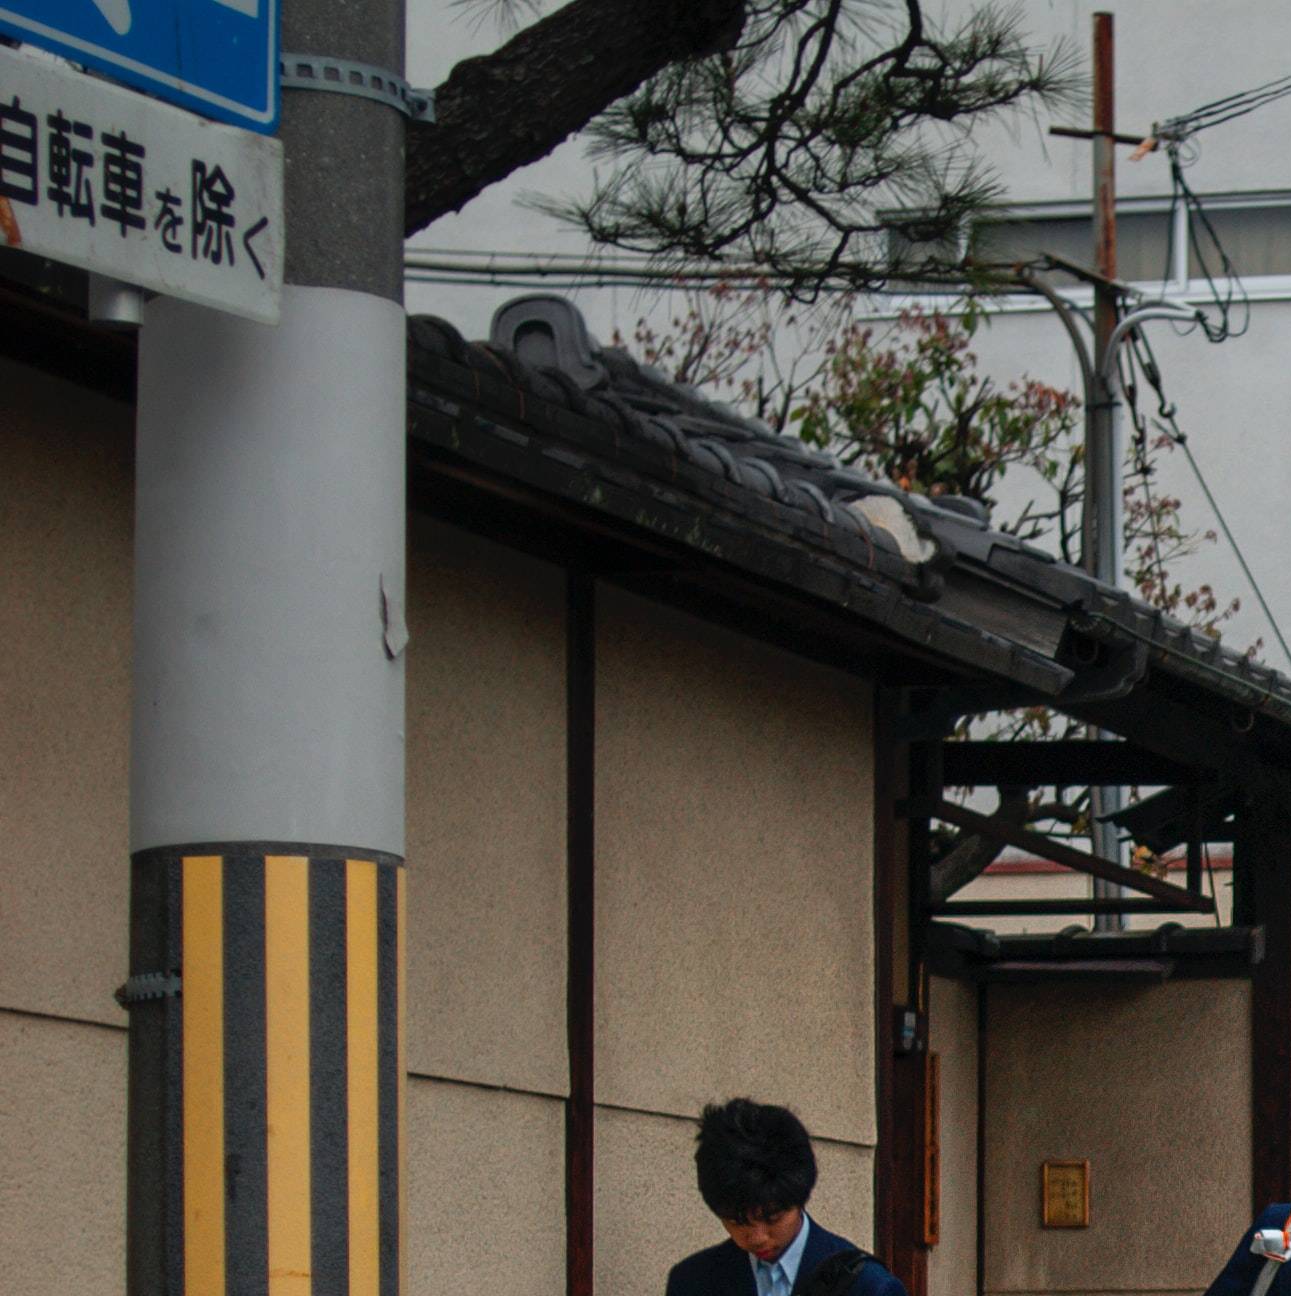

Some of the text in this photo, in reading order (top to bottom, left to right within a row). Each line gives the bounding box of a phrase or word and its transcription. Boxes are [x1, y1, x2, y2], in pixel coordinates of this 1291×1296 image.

[0, 95, 269, 281] 自転車を除く
